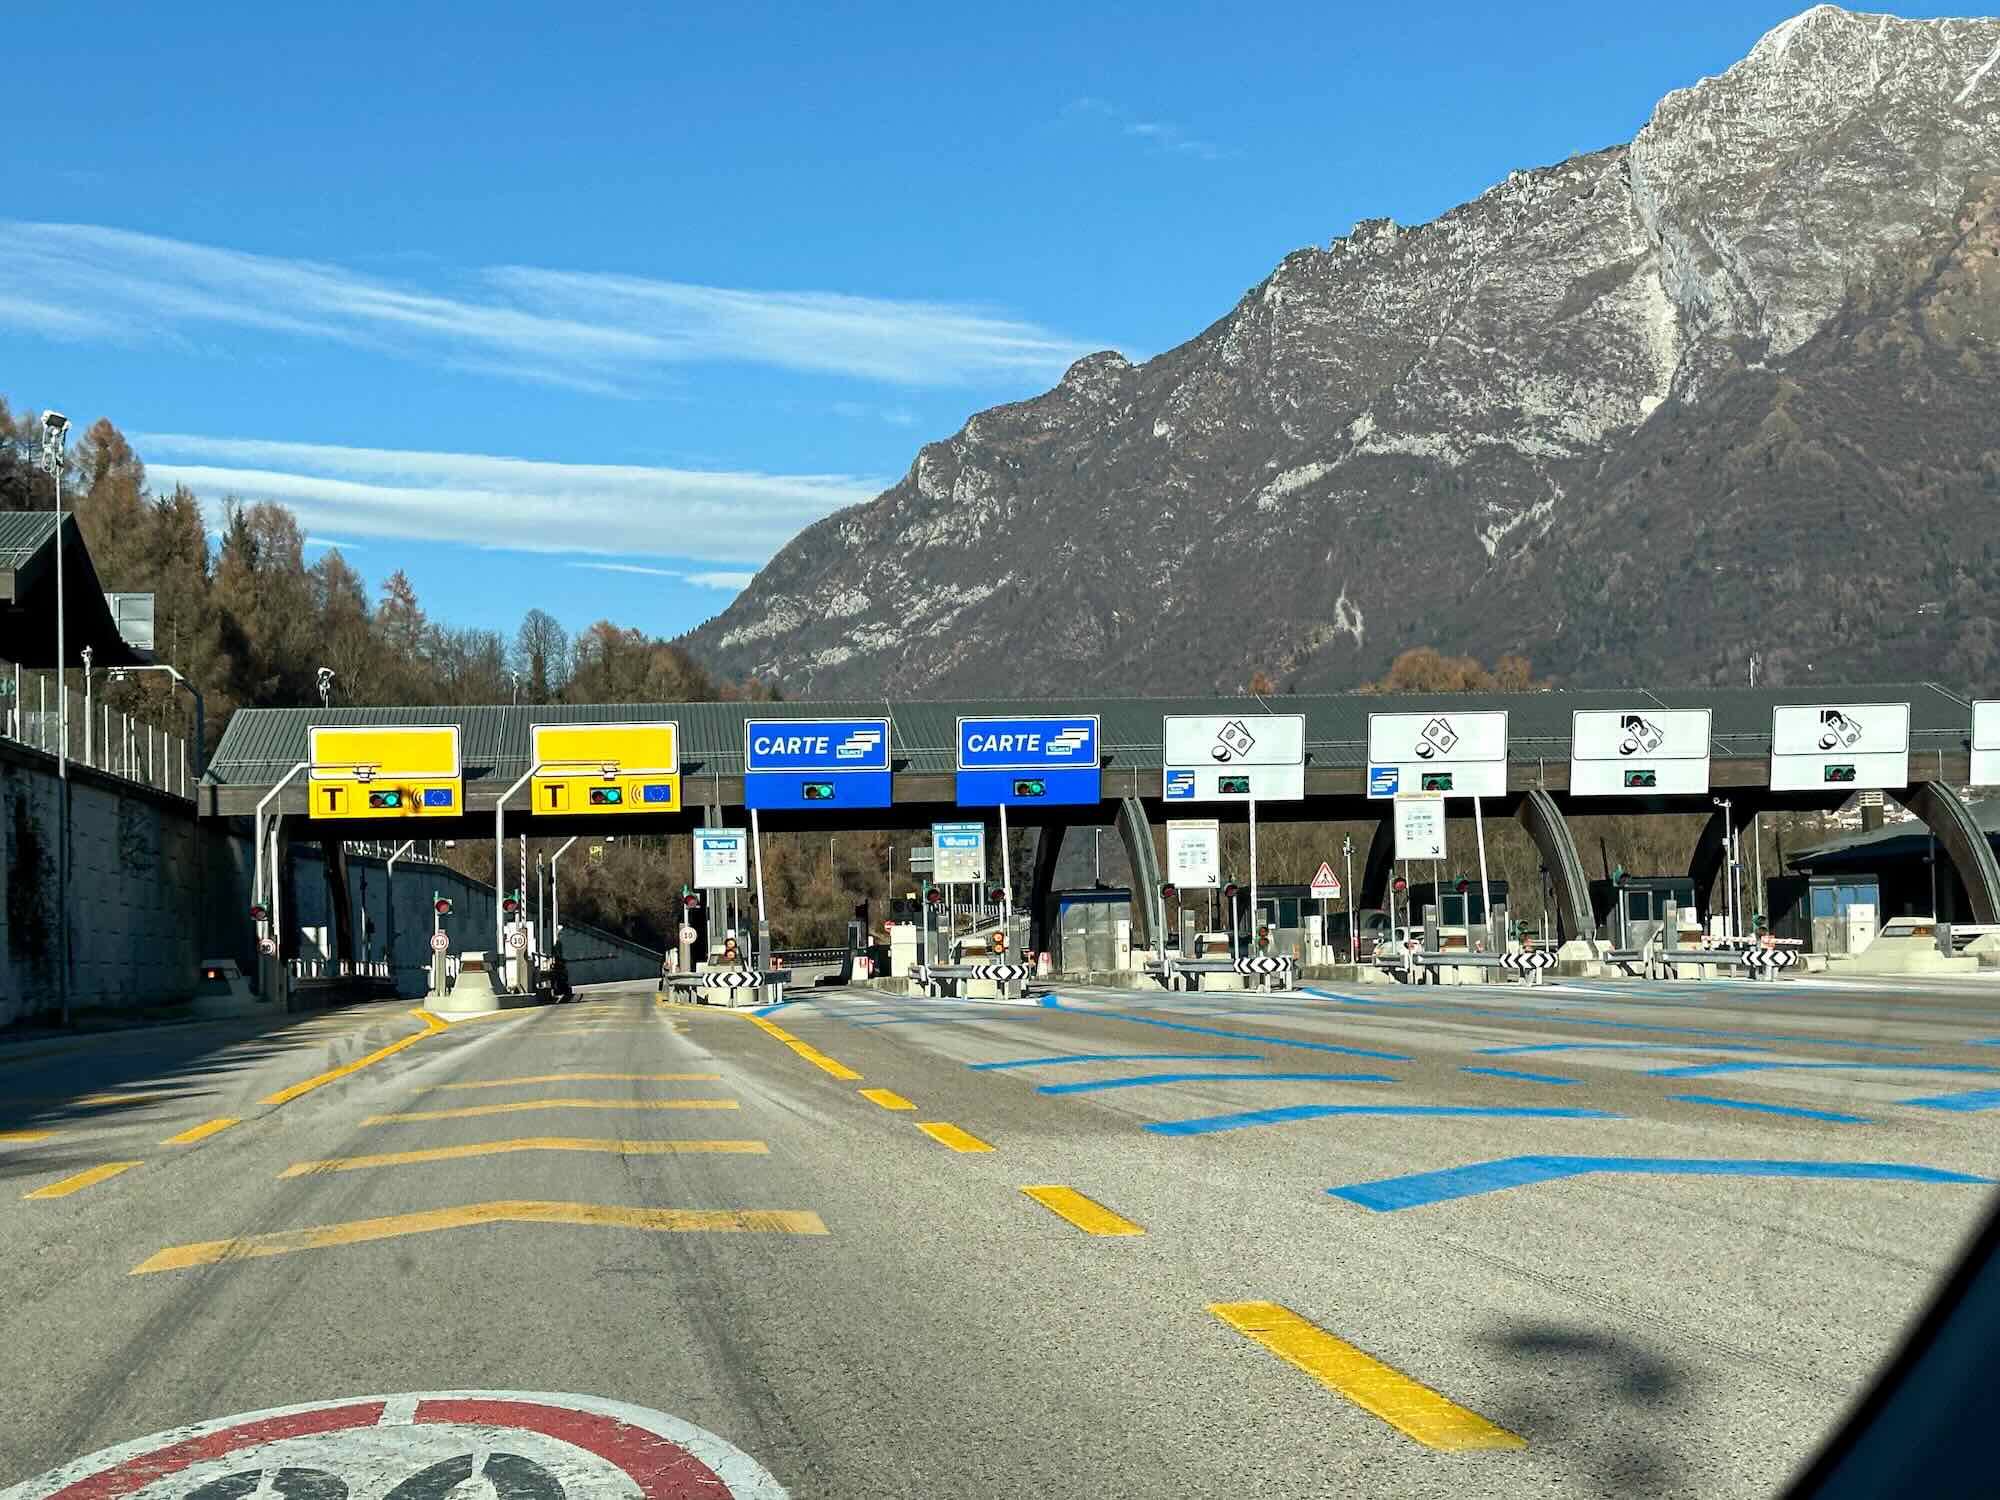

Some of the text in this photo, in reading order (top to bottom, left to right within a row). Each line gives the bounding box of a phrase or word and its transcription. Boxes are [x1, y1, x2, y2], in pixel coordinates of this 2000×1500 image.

[754, 736, 830, 755] CARTE
[967, 734, 1041, 753] CARTE
[322, 787, 343, 811] T
[544, 784, 564, 808] T
